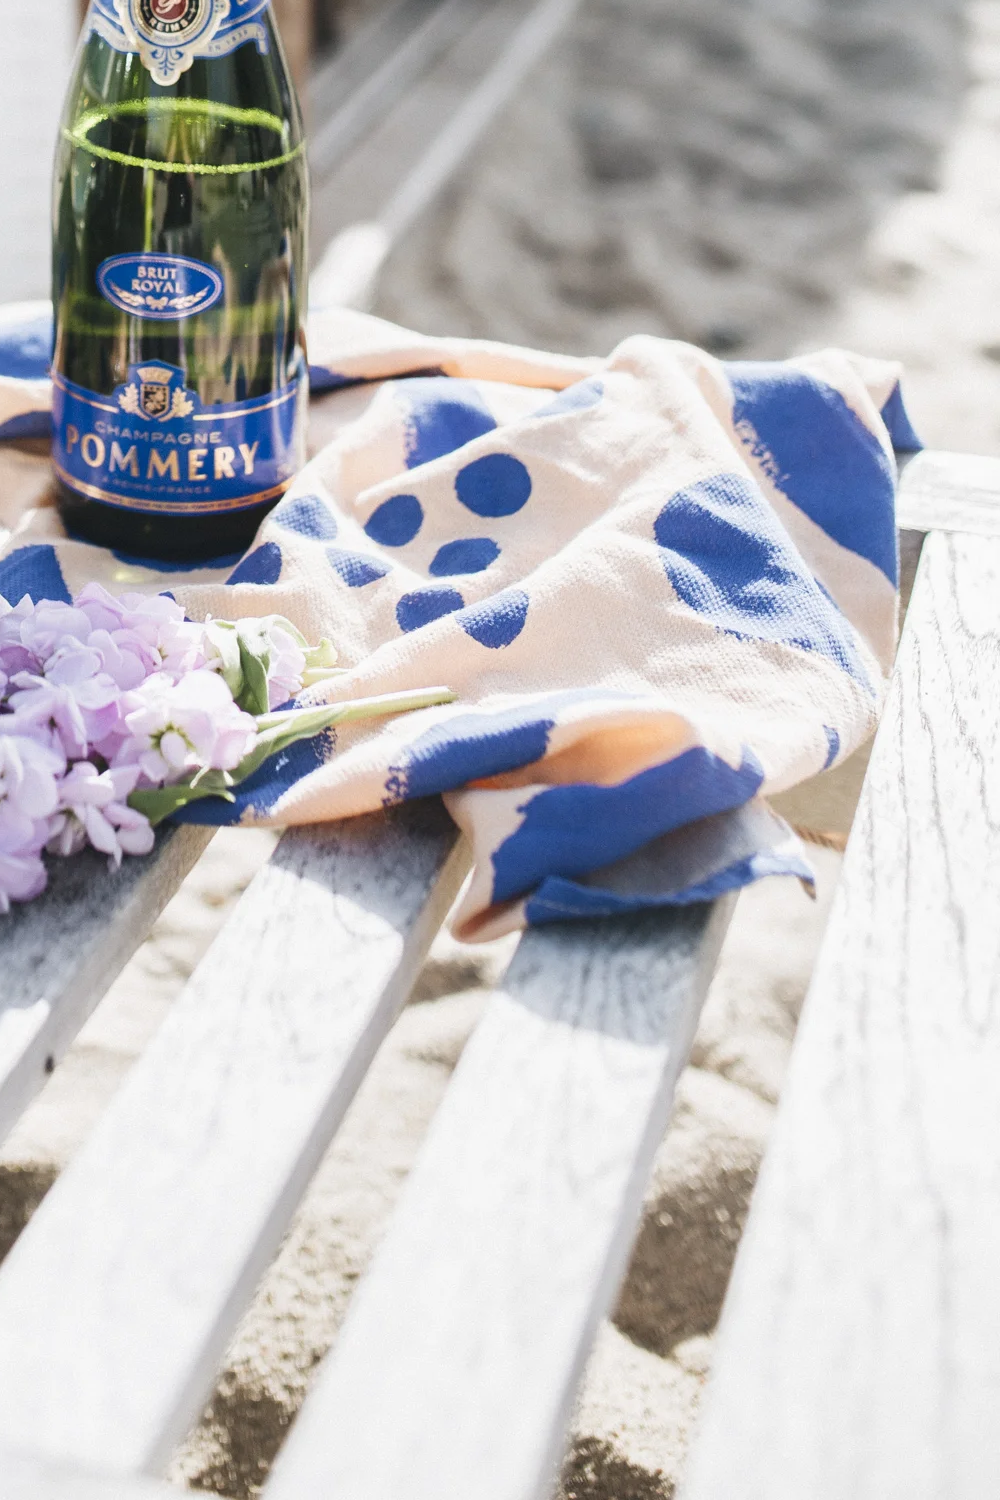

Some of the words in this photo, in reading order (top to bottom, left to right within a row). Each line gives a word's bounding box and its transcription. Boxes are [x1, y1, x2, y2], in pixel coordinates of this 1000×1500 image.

[149, 17, 189, 32] REIMS
[137, 265, 177, 279] BRUT
[131, 278, 184, 293] ROYAL
[95, 420, 222, 445] CHAMPAGNE
[66, 423, 259, 482] POMMERY
